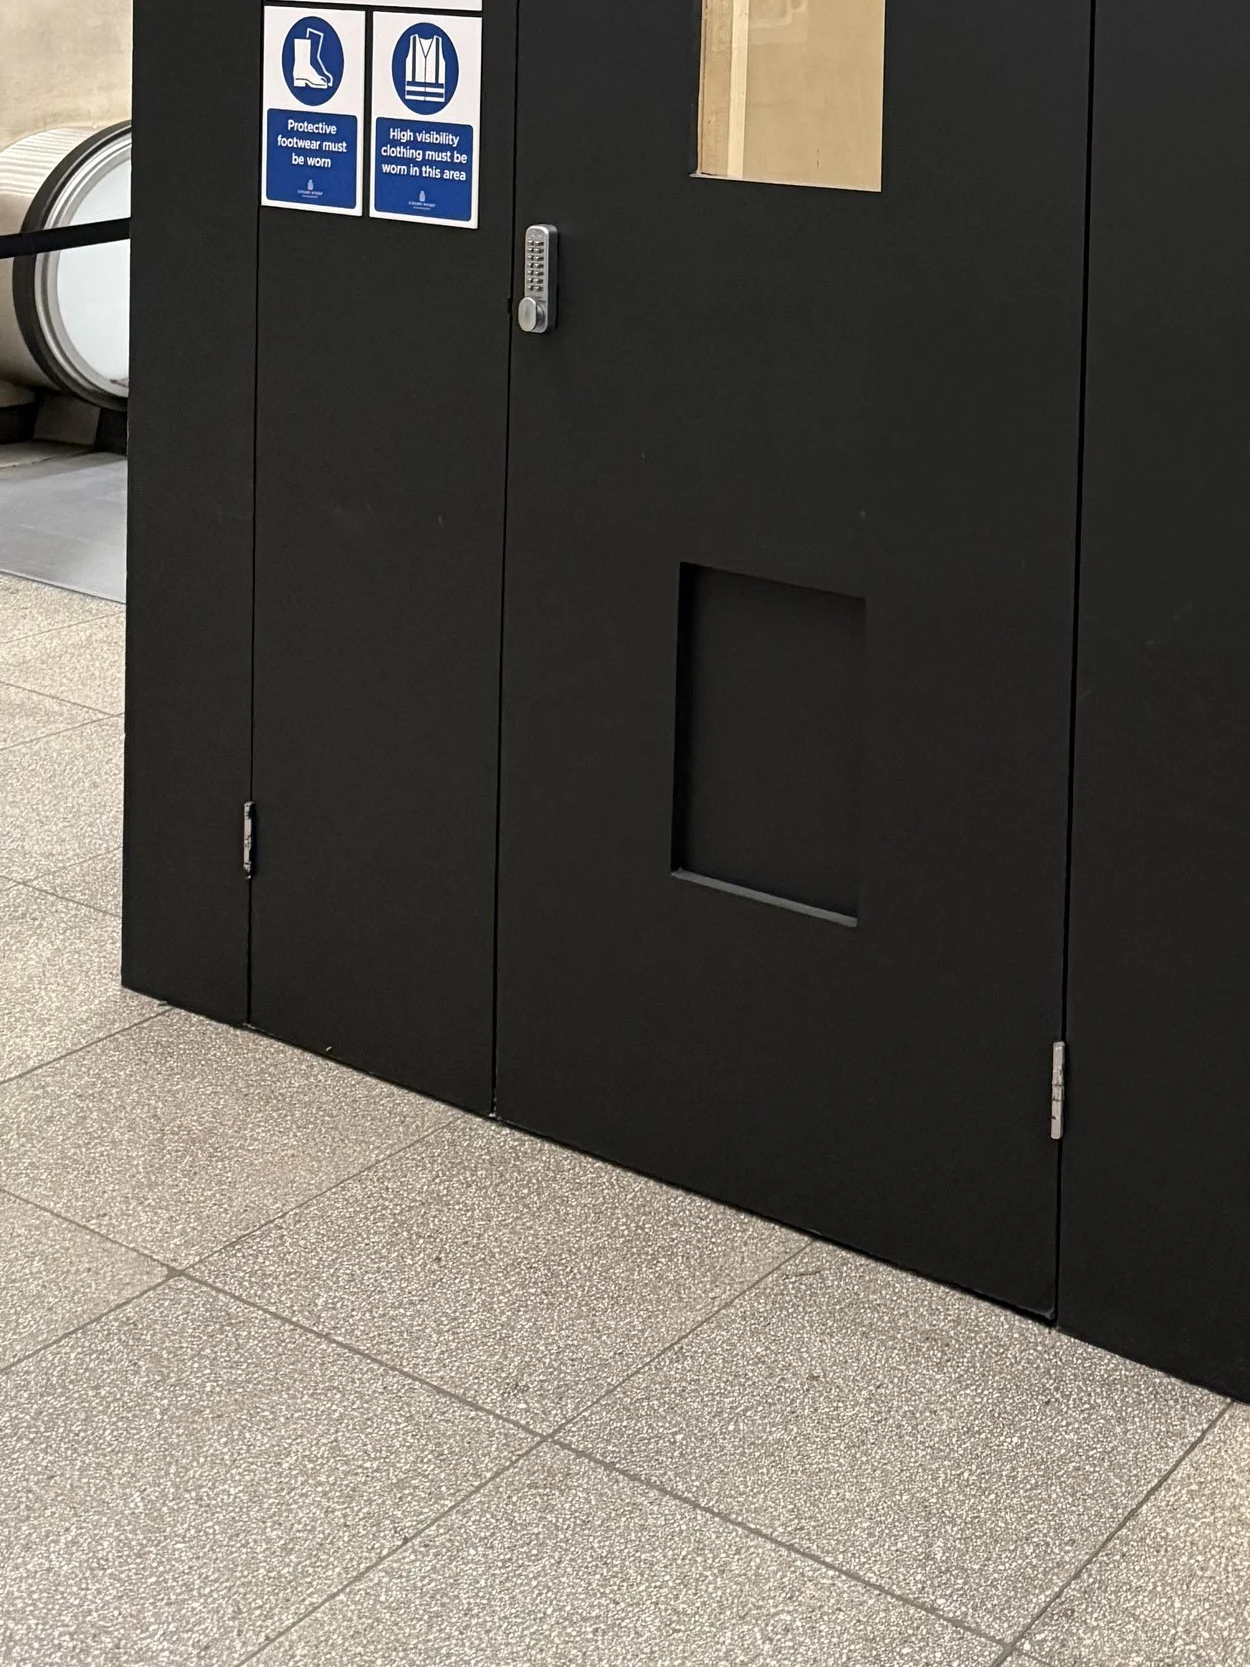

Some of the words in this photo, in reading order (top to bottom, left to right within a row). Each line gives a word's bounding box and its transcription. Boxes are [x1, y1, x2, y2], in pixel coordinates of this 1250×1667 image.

[287, 119, 337, 136] Protective
[389, 127, 414, 145] High
[415, 128, 460, 146] visibility
[277, 135, 321, 152] footwear
[322, 139, 347, 153] must
[291, 152, 304, 167] be
[305, 156, 332, 169] worn
[381, 144, 424, 162] clothing
[425, 148, 452, 163] must
[453, 149, 468, 164] be
[381, 162, 408, 176] worn
[410, 163, 420, 176] in
[422, 163, 442, 178] this
[444, 168, 467, 181] area
